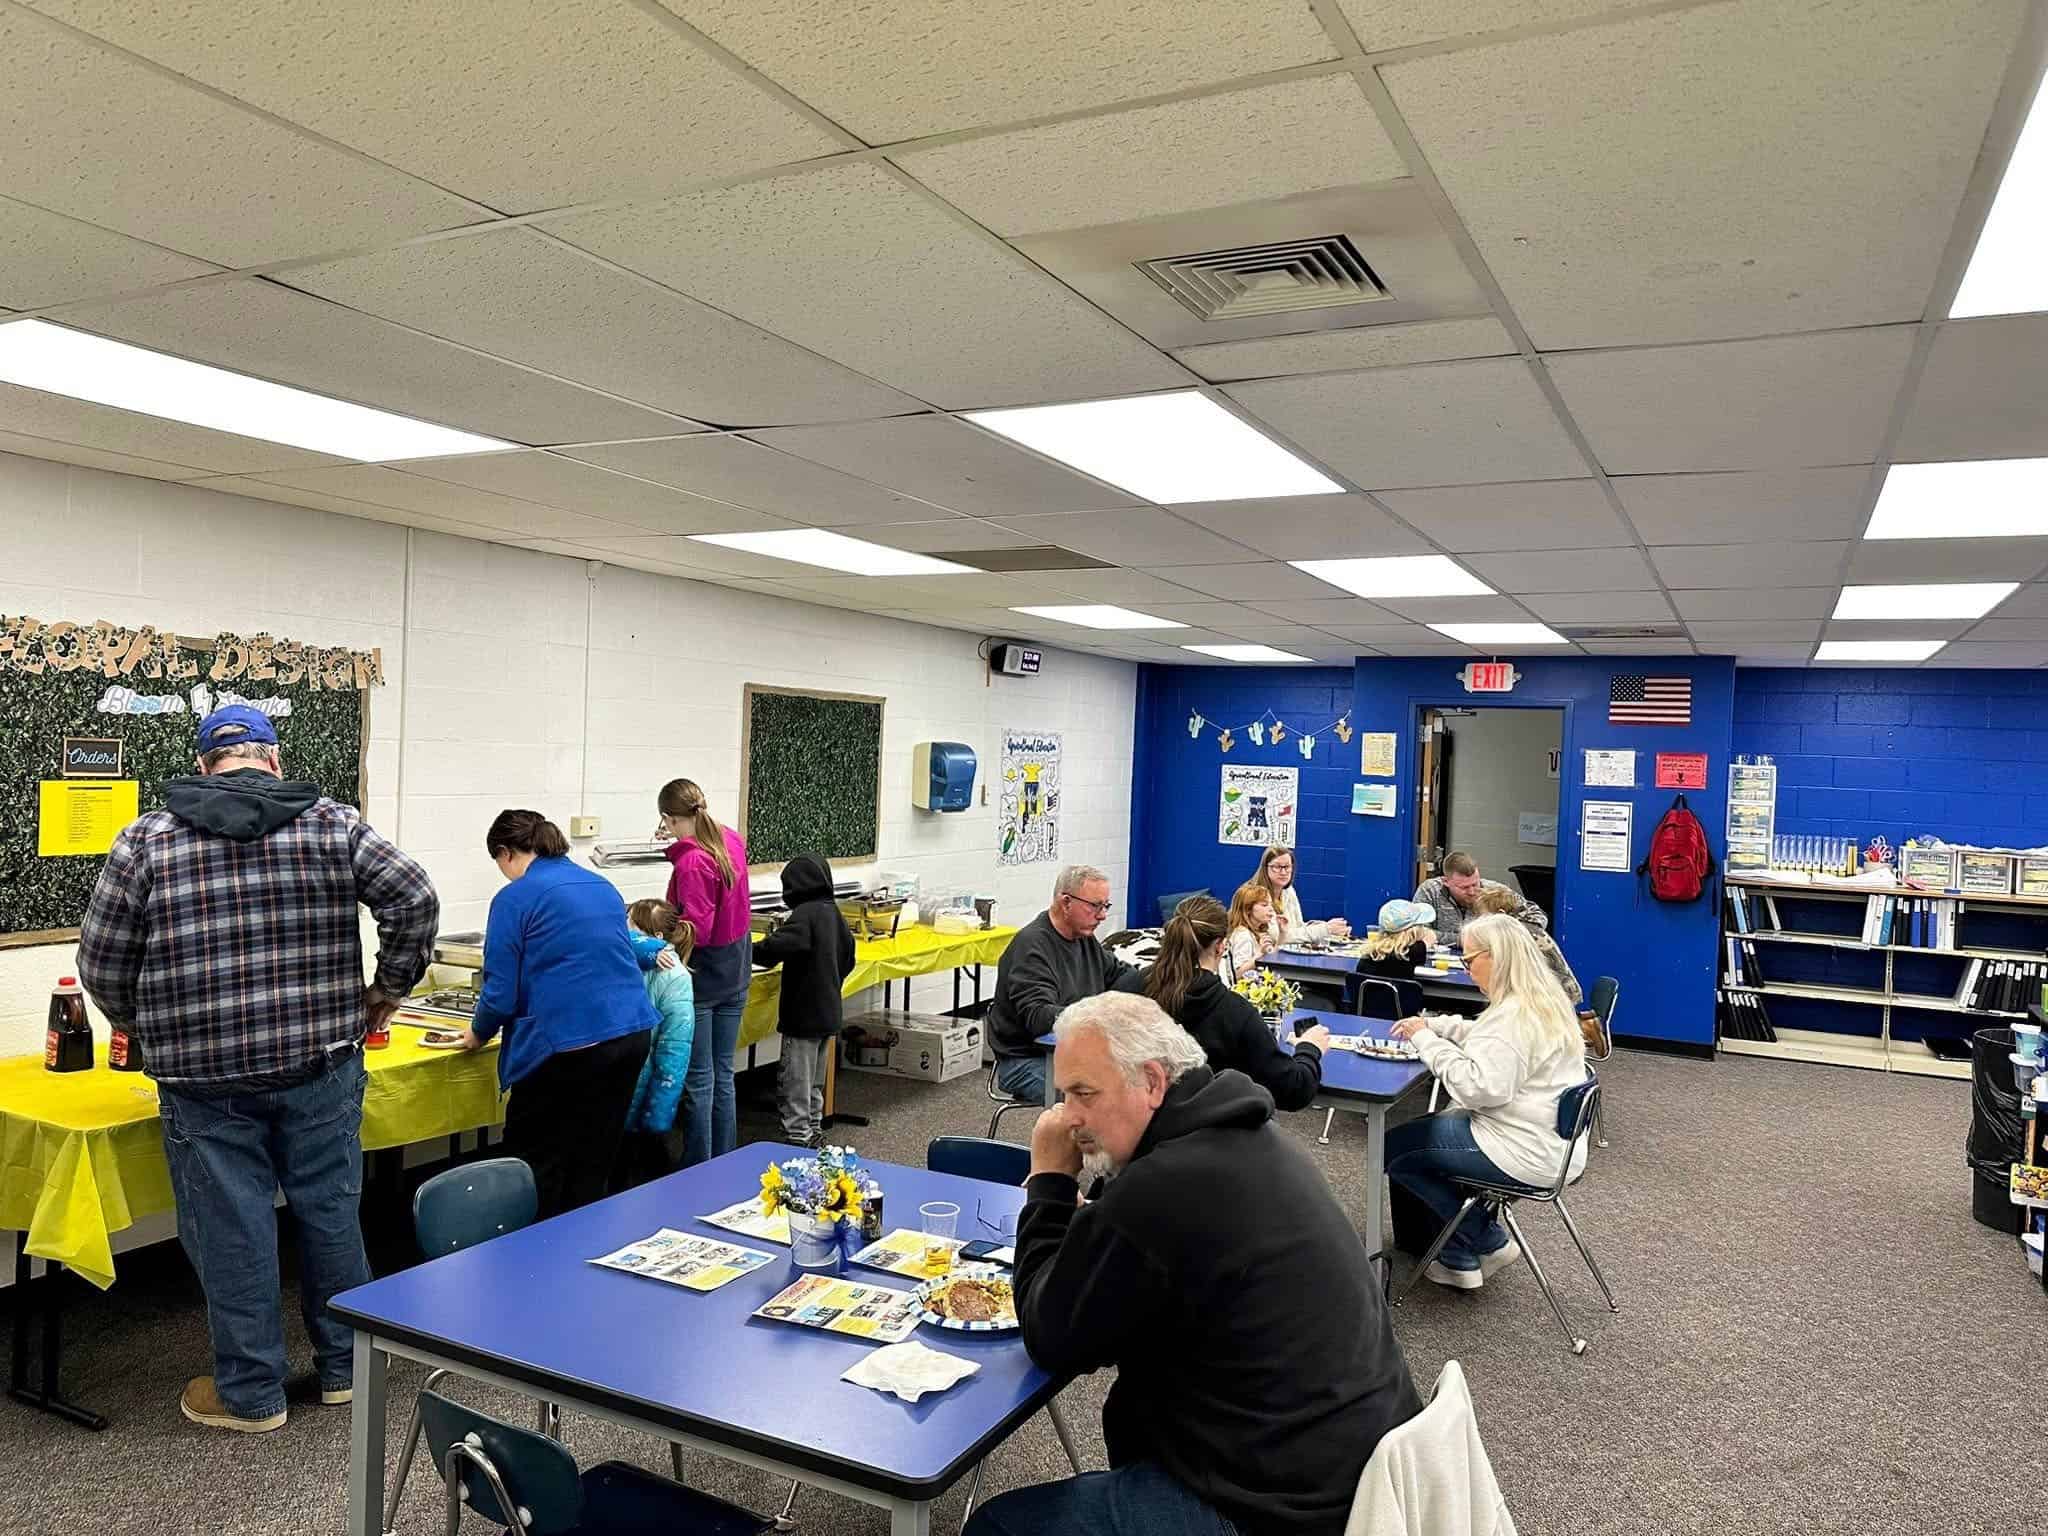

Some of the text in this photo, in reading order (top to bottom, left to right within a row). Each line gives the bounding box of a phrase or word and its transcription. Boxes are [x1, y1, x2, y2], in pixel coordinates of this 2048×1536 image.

[209, 632, 385, 692] DESIGN
[1472, 664, 1506, 688] EXIT
[98, 685, 185, 714] Bloom
[66, 747, 117, 765] Orders
